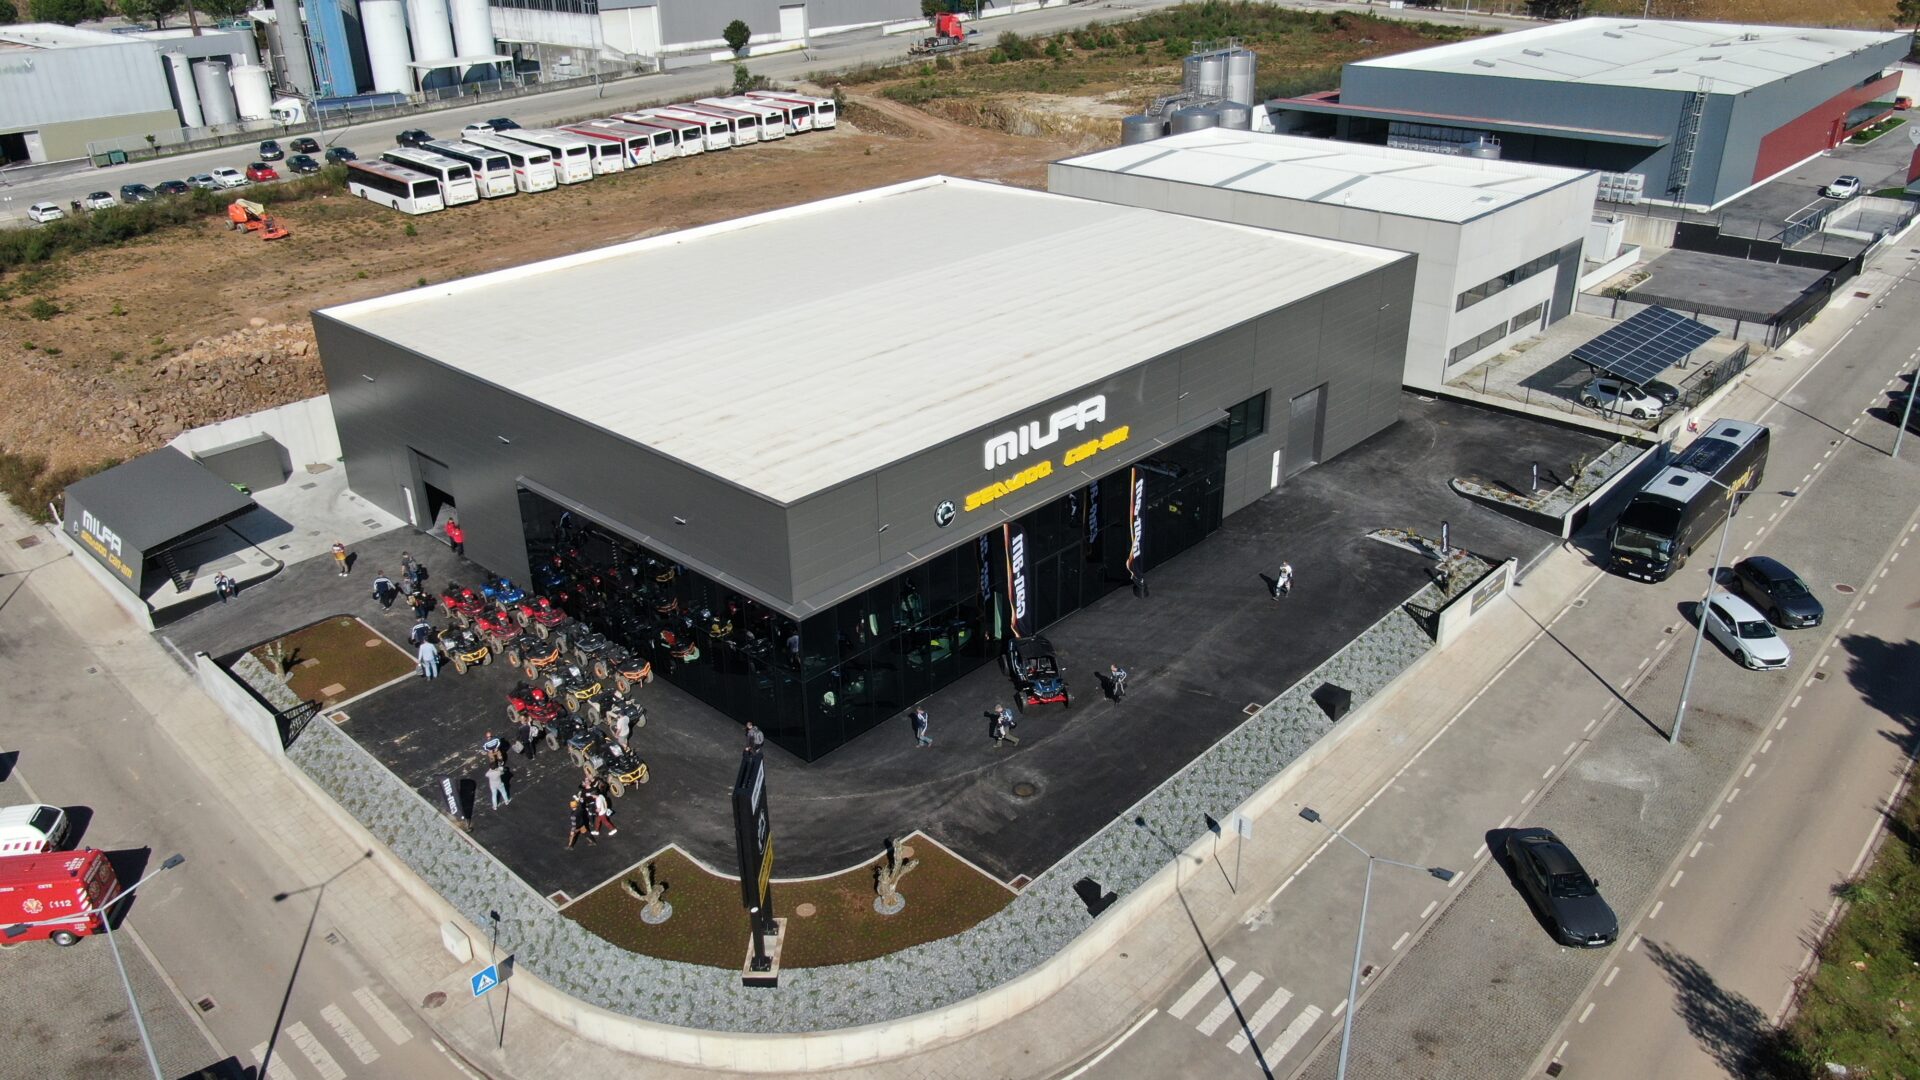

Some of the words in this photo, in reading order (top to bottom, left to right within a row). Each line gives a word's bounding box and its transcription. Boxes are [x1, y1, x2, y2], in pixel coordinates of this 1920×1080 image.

[984, 394, 1106, 471] MILFA
[82, 509, 122, 557] MILFA
[54, 899, 72, 908] 112
